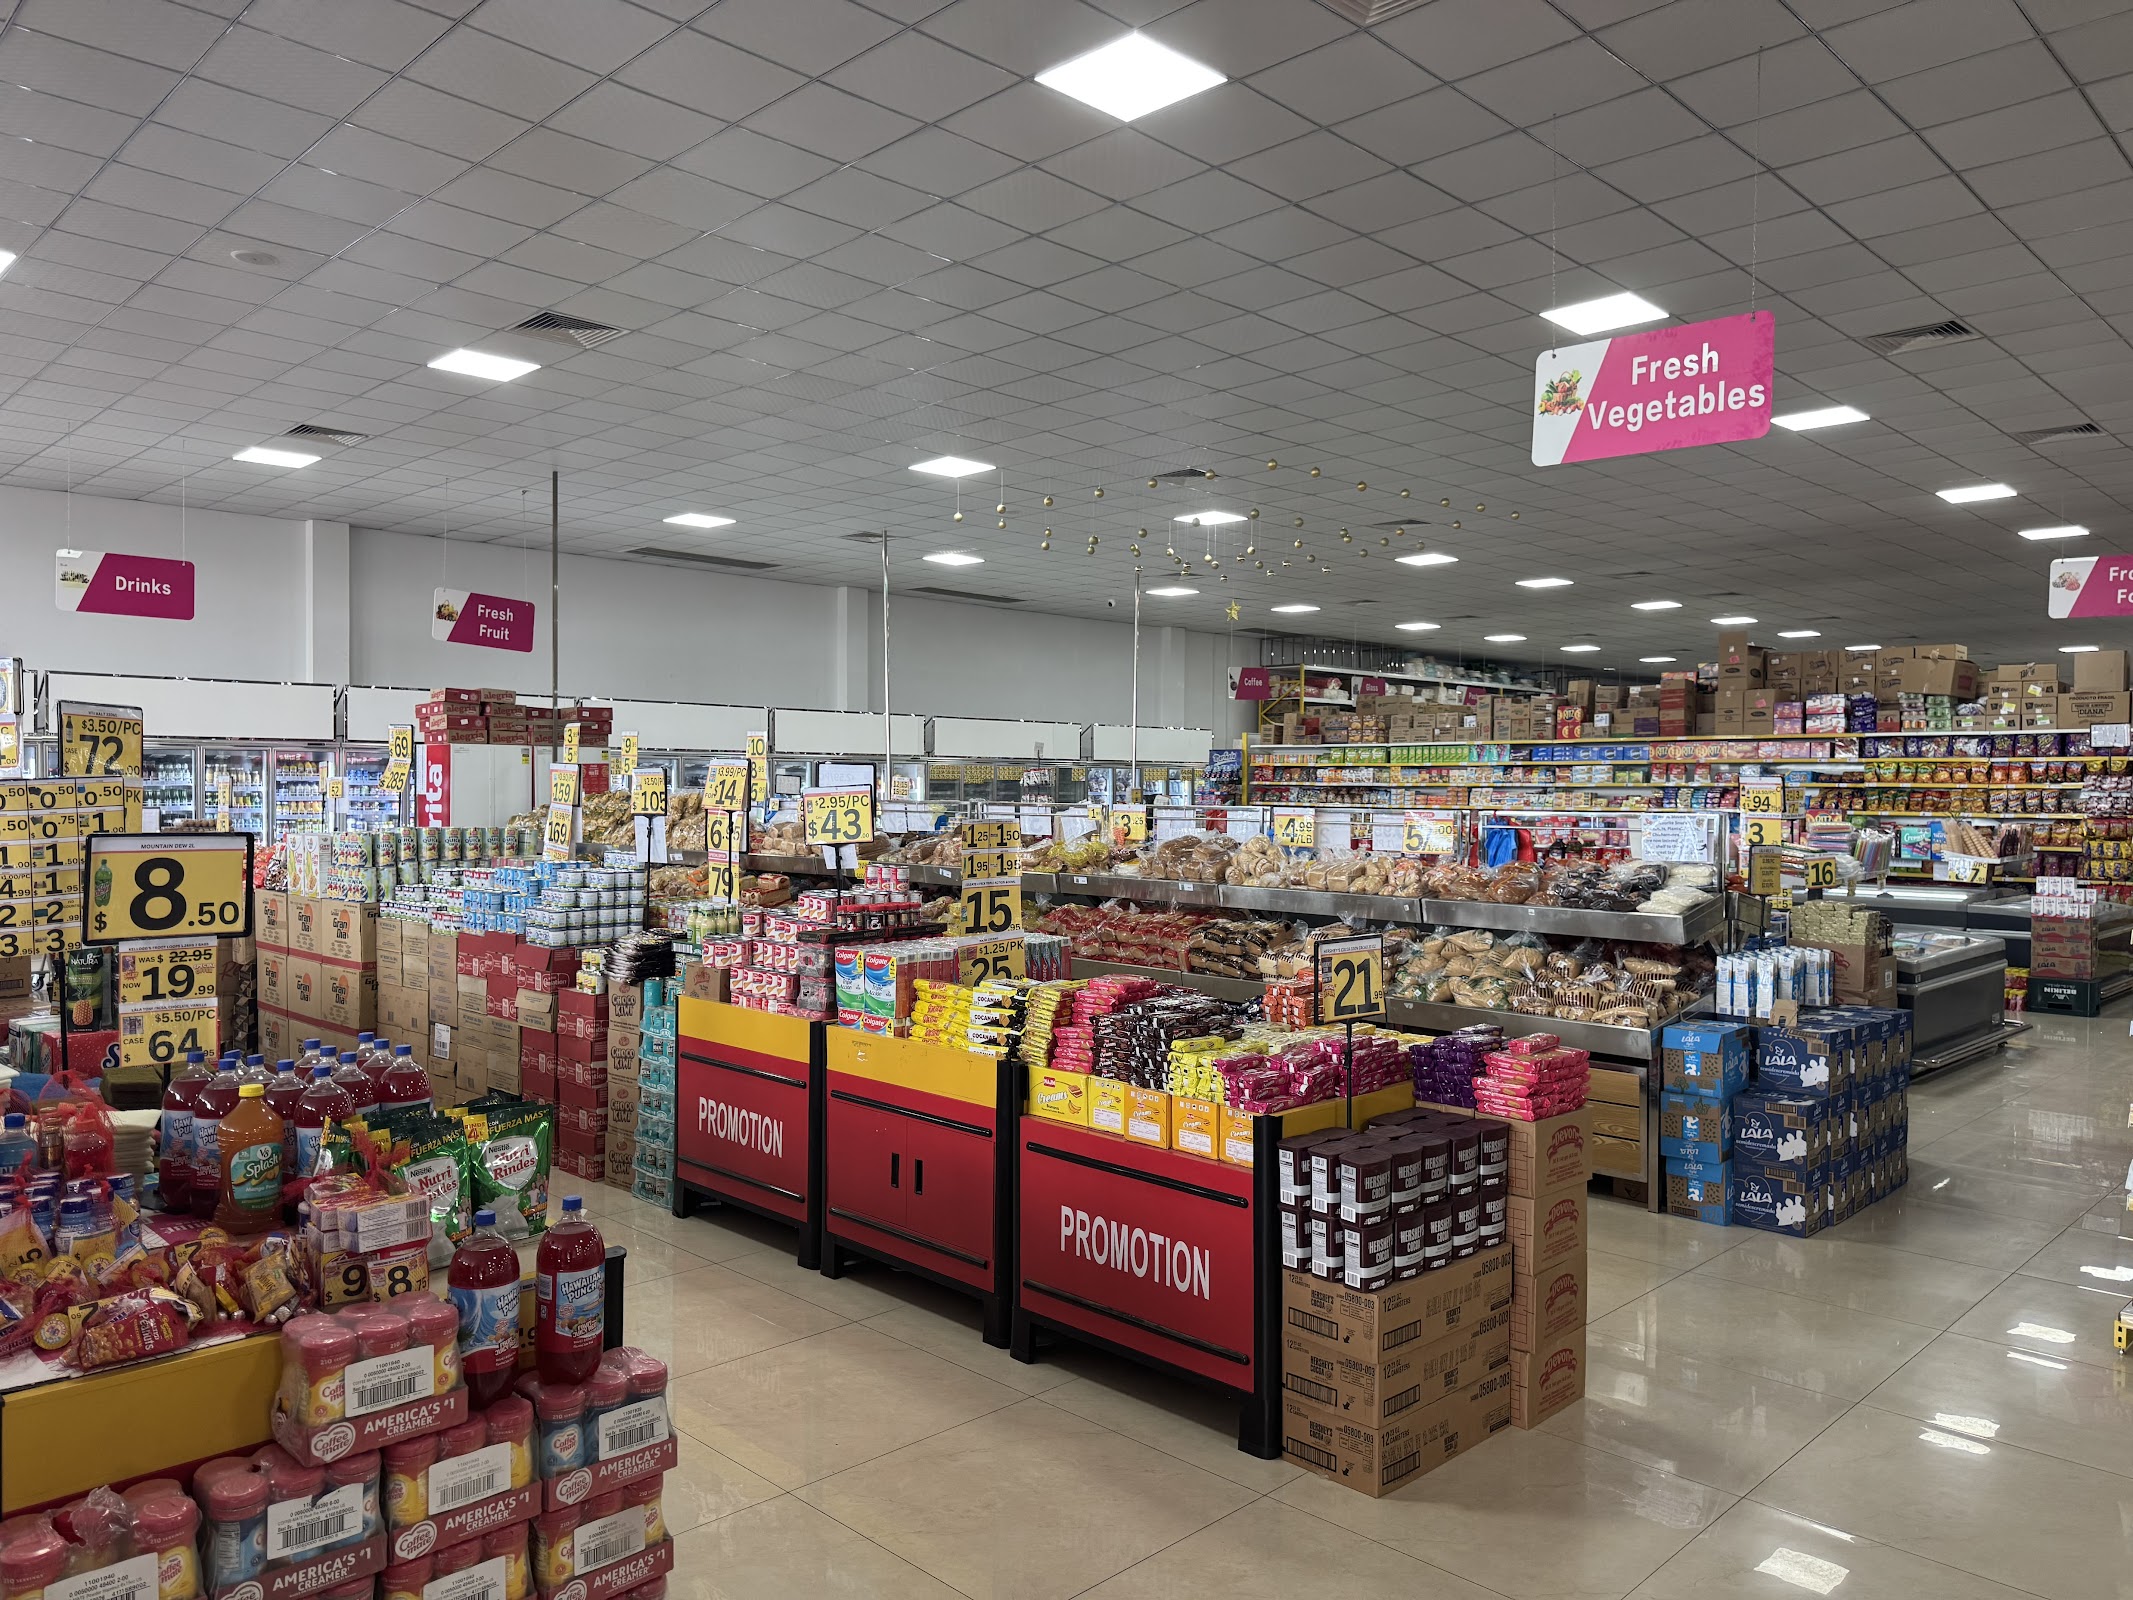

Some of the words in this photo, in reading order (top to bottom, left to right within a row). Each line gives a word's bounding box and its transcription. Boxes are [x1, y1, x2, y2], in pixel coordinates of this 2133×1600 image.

[1631, 342, 1720, 386] Fresh
[1588, 380, 1766, 432] Vegetables
[115, 575, 172, 595] Drinks
[477, 604, 514, 622] Fresh
[479, 625, 510, 641] Fruit
[1243, 677, 1263, 688] Coffee
[815, 794, 869, 809] $2.95/PC
[835, 951, 856, 960] Colgate
[979, 939, 1024, 955] $1.25/PK
[866, 955, 888, 966] Colgate
[155, 1009, 216, 1023] $5.50/PC
[838, 1011, 859, 1021] Colgate
[863, 1016, 885, 1027] Colgate
[123, 1037, 145, 1045] CASE
[1681, 1035, 1701, 1043] LALA
[1764, 1054, 1797, 1066] LALA
[1037, 1089, 1069, 1105] Creams
[488, 1118, 523, 1135] FUERZA
[699, 1096, 783, 1158] PROMOTION
[1741, 1128, 1774, 1139] LALA
[410, 1138, 441, 1159] FUERZA
[245, 1154, 279, 1179] Splash
[492, 1156, 536, 1182] Rindes
[418, 1165, 452, 1189] Nutri
[426, 1179, 457, 1200] indes
[1740, 1192, 1773, 1203] LALA
[1060, 1205, 1210, 1301] PROMOTION
[560, 1270, 601, 1296] HAWAIIAN
[567, 1283, 601, 1303] PUNCH
[1310, 1289, 1335, 1305] HERSHEY'S
[1310, 1298, 1326, 1309] COCOA
[138, 1312, 154, 1350] Peanuts
[320, 1357, 332, 1366] 210
[1310, 1355, 1334, 1371] HERSHEY'S
[1310, 1364, 1325, 1376] COCOA
[364, 1402, 441, 1435] AMERICA'S
[386, 1415, 435, 1436] CREAMER
[1309, 1420, 1333, 1437] HERSHEY'S
[1309, 1429, 1324, 1440] COCOA
[314, 1433, 349, 1452] Coffee
[322, 1438, 351, 1458] mate
[598, 1447, 661, 1478] AMERICA'S
[617, 1459, 656, 1479] CREAMER
[559, 1477, 587, 1496] Coffee
[566, 1482, 590, 1500] mate
[445, 1496, 517, 1531] AMERICA'S
[465, 1510, 511, 1531] CREAMER
[400, 1531, 431, 1550] Coffee
[406, 1536, 433, 1556] mate
[272, 1552, 356, 1592] AMERICA'S
[297, 1567, 349, 1592] CREAMER
[593, 1552, 655, 1589] AMERICA'S
[611, 1566, 649, 1589] CREAMER
